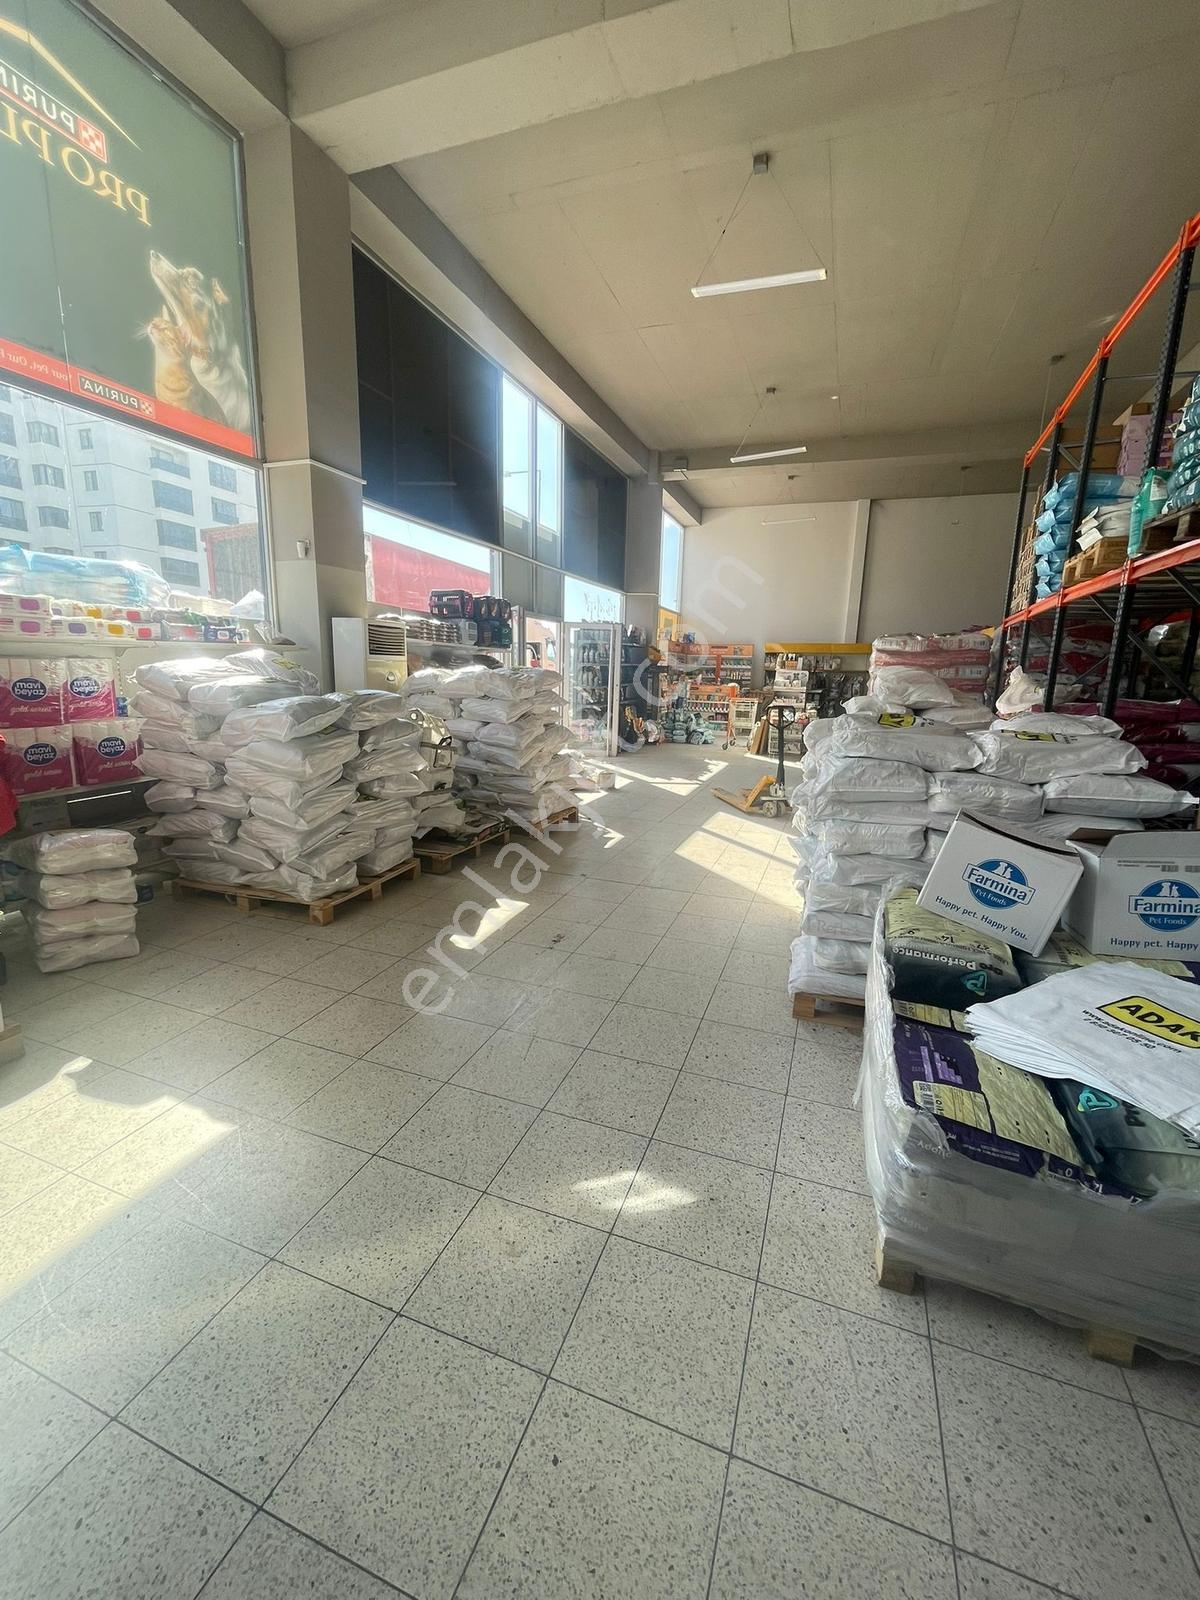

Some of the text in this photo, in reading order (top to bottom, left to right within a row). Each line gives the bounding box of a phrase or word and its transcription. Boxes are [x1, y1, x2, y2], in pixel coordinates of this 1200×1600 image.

[16, 681, 41, 690] mavi
[73, 679, 95, 687] mavi
[14, 687, 45, 697] beyaz
[101, 739, 121, 748] mavi
[27, 745, 52, 754] mavi
[100, 745, 124, 755] beyaz
[26, 751, 55, 761] beyaz
[967, 867, 1028, 902] Farmina
[975, 888, 1007, 906] Pet Foods
[935, 895, 1028, 940] Happy pet. Happy You.
[1164, 917, 1187, 925] Foods
[1110, 937, 1199, 951] Happy pet. Happy
